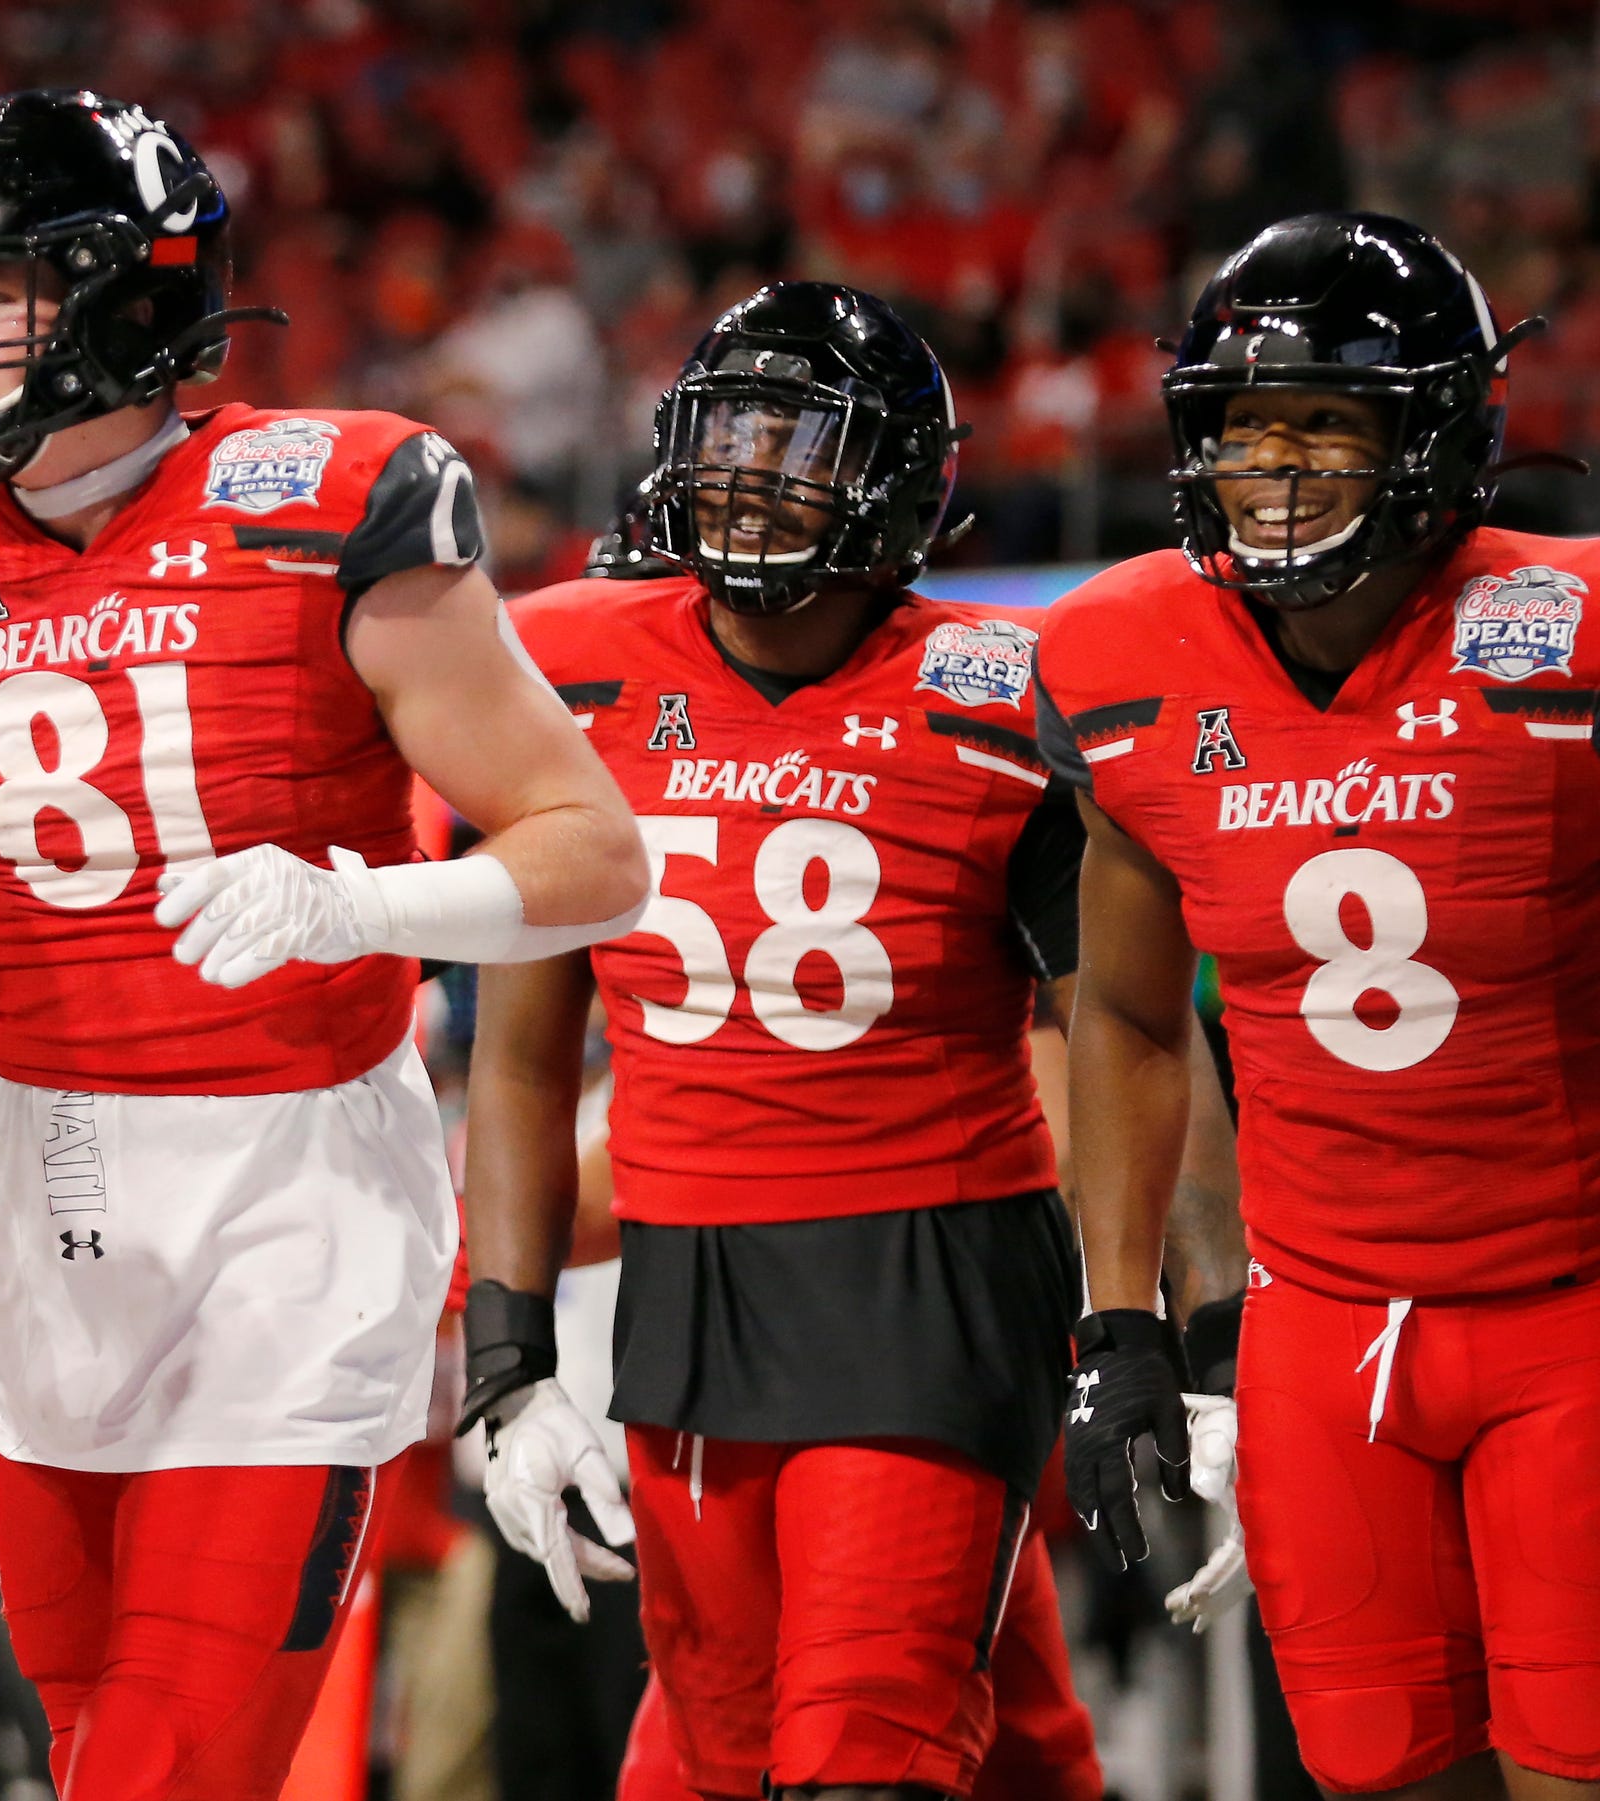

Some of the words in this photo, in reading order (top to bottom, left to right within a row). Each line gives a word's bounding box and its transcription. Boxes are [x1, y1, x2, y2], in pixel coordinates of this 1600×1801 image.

[755, 350, 775, 369] C
[1246, 334, 1266, 357] C
[212, 459, 322, 489] PEACH
[230, 481, 294, 494] BOWL
[1459, 622, 1573, 651] PEACH
[1477, 646, 1546, 659] BOWL
[924, 653, 1029, 690] PEACH
[647, 693, 696, 750] A
[1191, 707, 1247, 775] A
[663, 750, 878, 815] BEARCATS
[1217, 757, 1457, 831] BEARCATS
[632, 815, 895, 1051] 58
[1283, 847, 1462, 1072] 8
